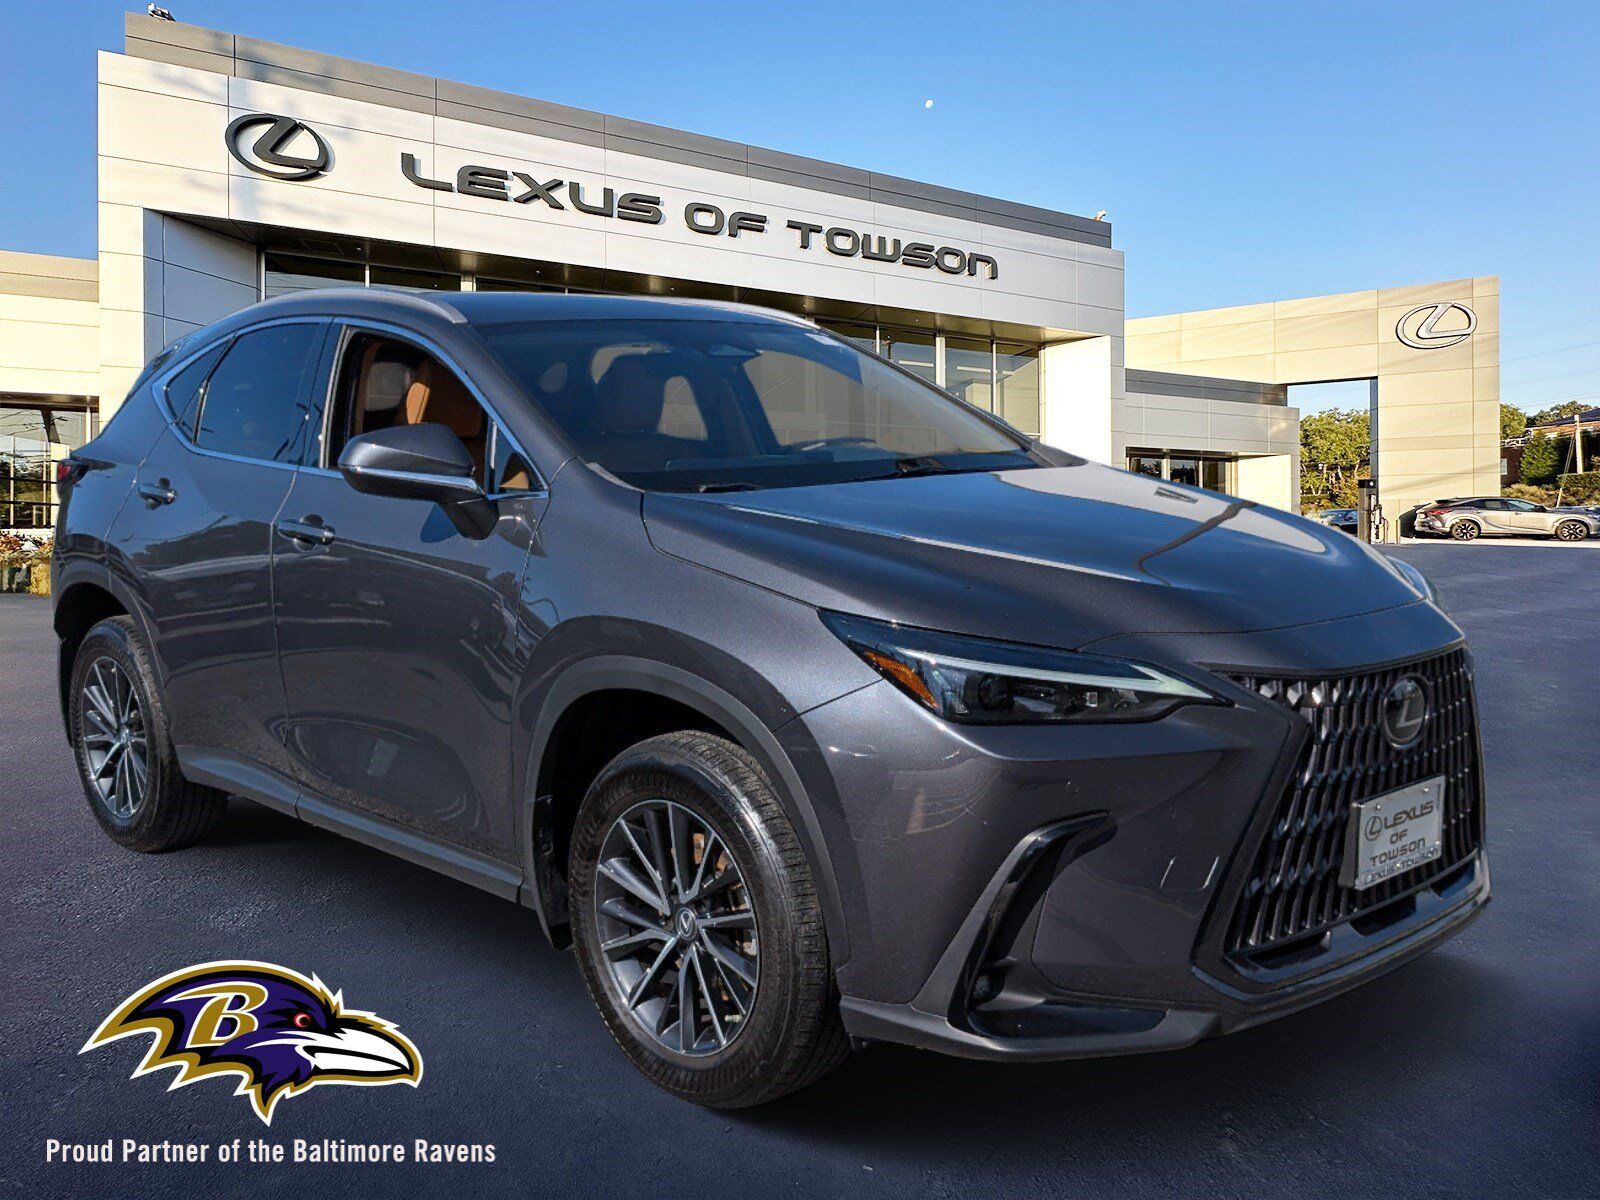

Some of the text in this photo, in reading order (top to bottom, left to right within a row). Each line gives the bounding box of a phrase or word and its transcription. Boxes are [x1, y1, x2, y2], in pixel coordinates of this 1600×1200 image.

[401, 152, 999, 280] LEXUS OF TOWSON
[1384, 801, 1434, 829] LEXUS
[1390, 828, 1408, 845] OF
[1370, 837, 1426, 867] TOWSON
